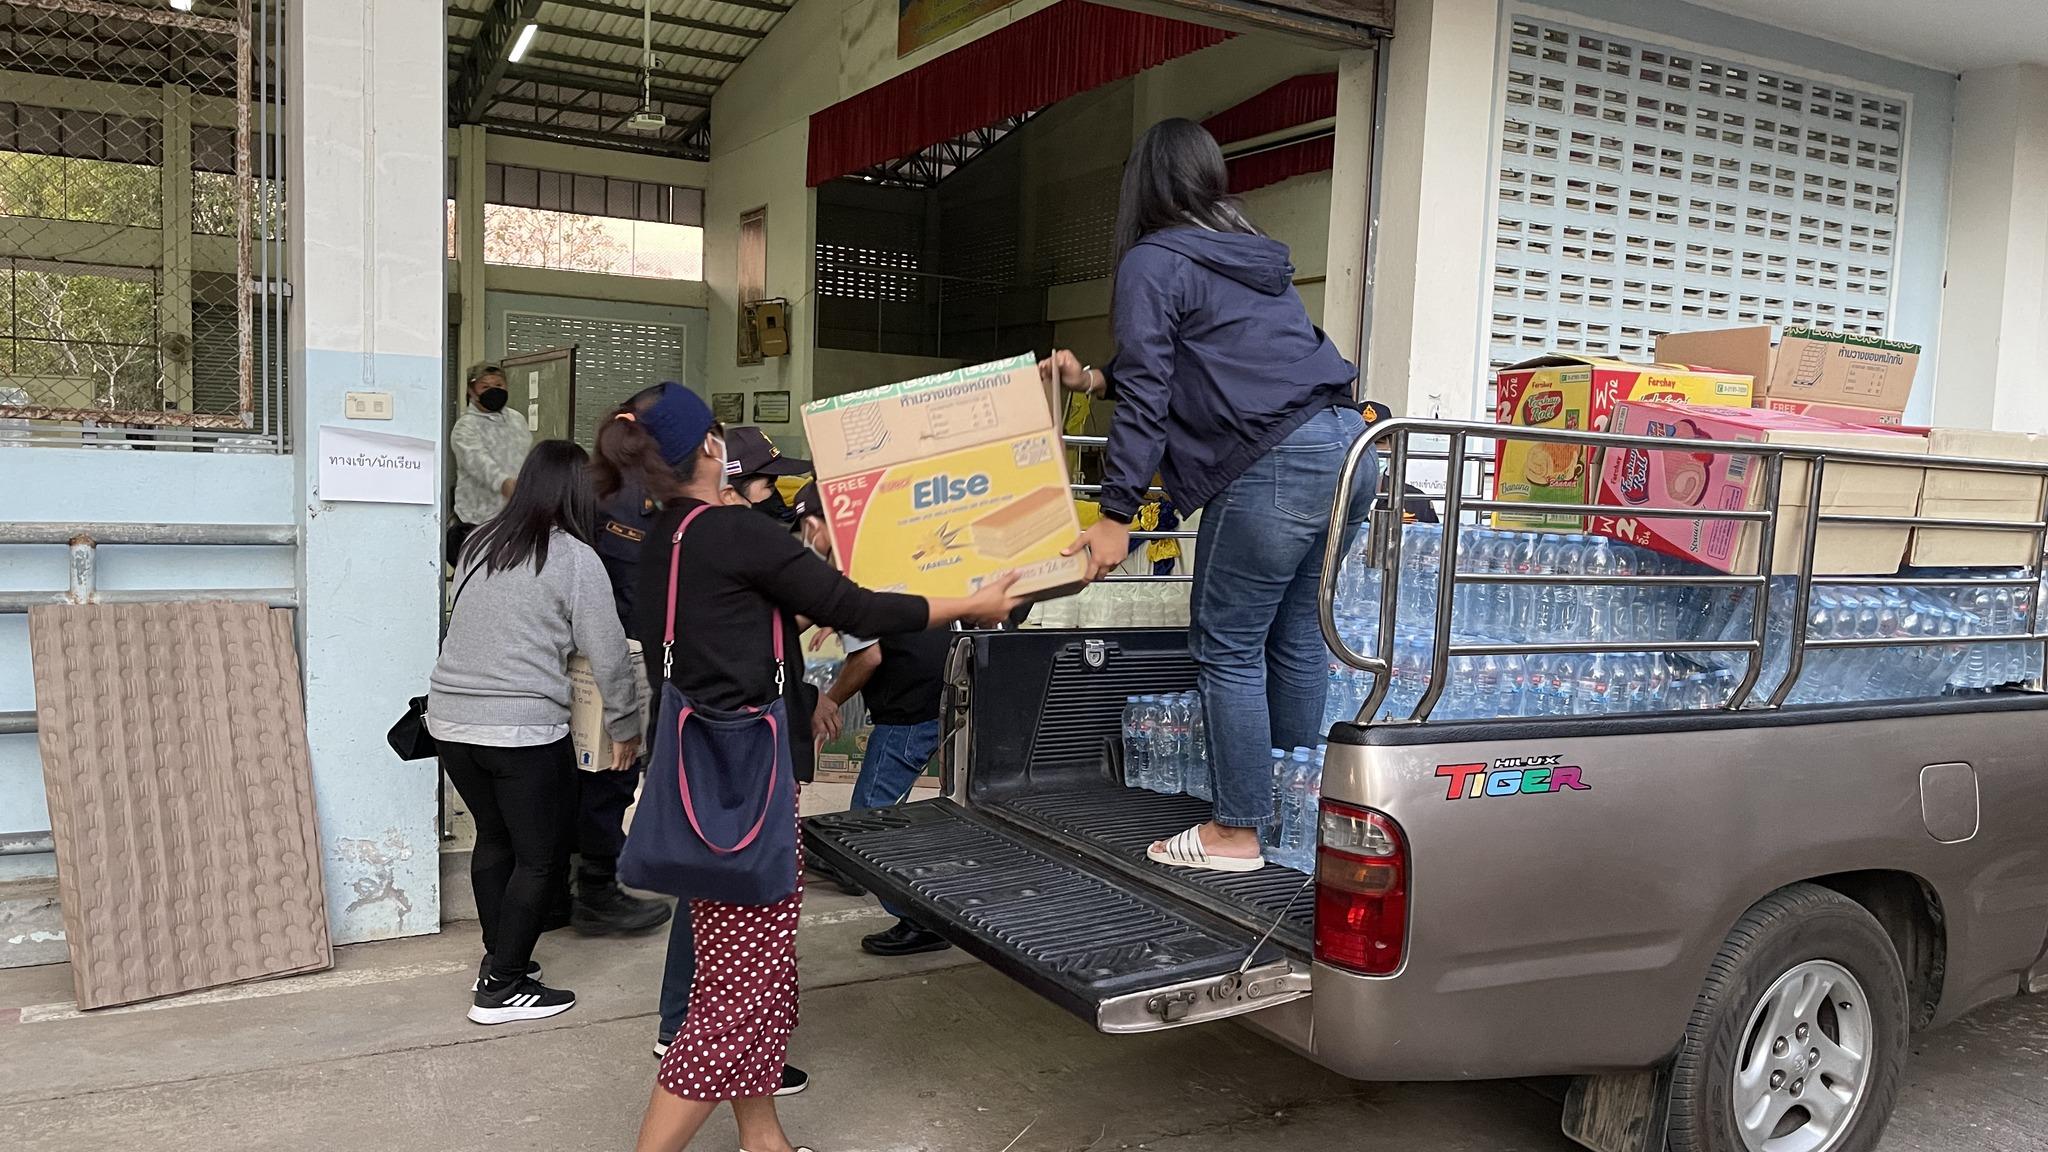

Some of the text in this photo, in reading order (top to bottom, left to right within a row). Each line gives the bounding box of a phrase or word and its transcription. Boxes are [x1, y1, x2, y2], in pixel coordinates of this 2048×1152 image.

[1501, 376, 1518, 398] ฟรี
[1648, 376, 1676, 389] Fershay
[1498, 401, 1512, 425] 2
[1531, 405, 1555, 422] Roll
[1772, 402, 1796, 414] FREE
[328, 452, 422, 470] ทางเข้า/นักเรียน
[828, 475, 868, 497] FREE
[912, 473, 990, 511] Ellse
[832, 494, 854, 520] 2
[1616, 517, 1638, 541] 2
[1493, 754, 1564, 769] HILUX
[1434, 762, 1592, 800] TIGER
